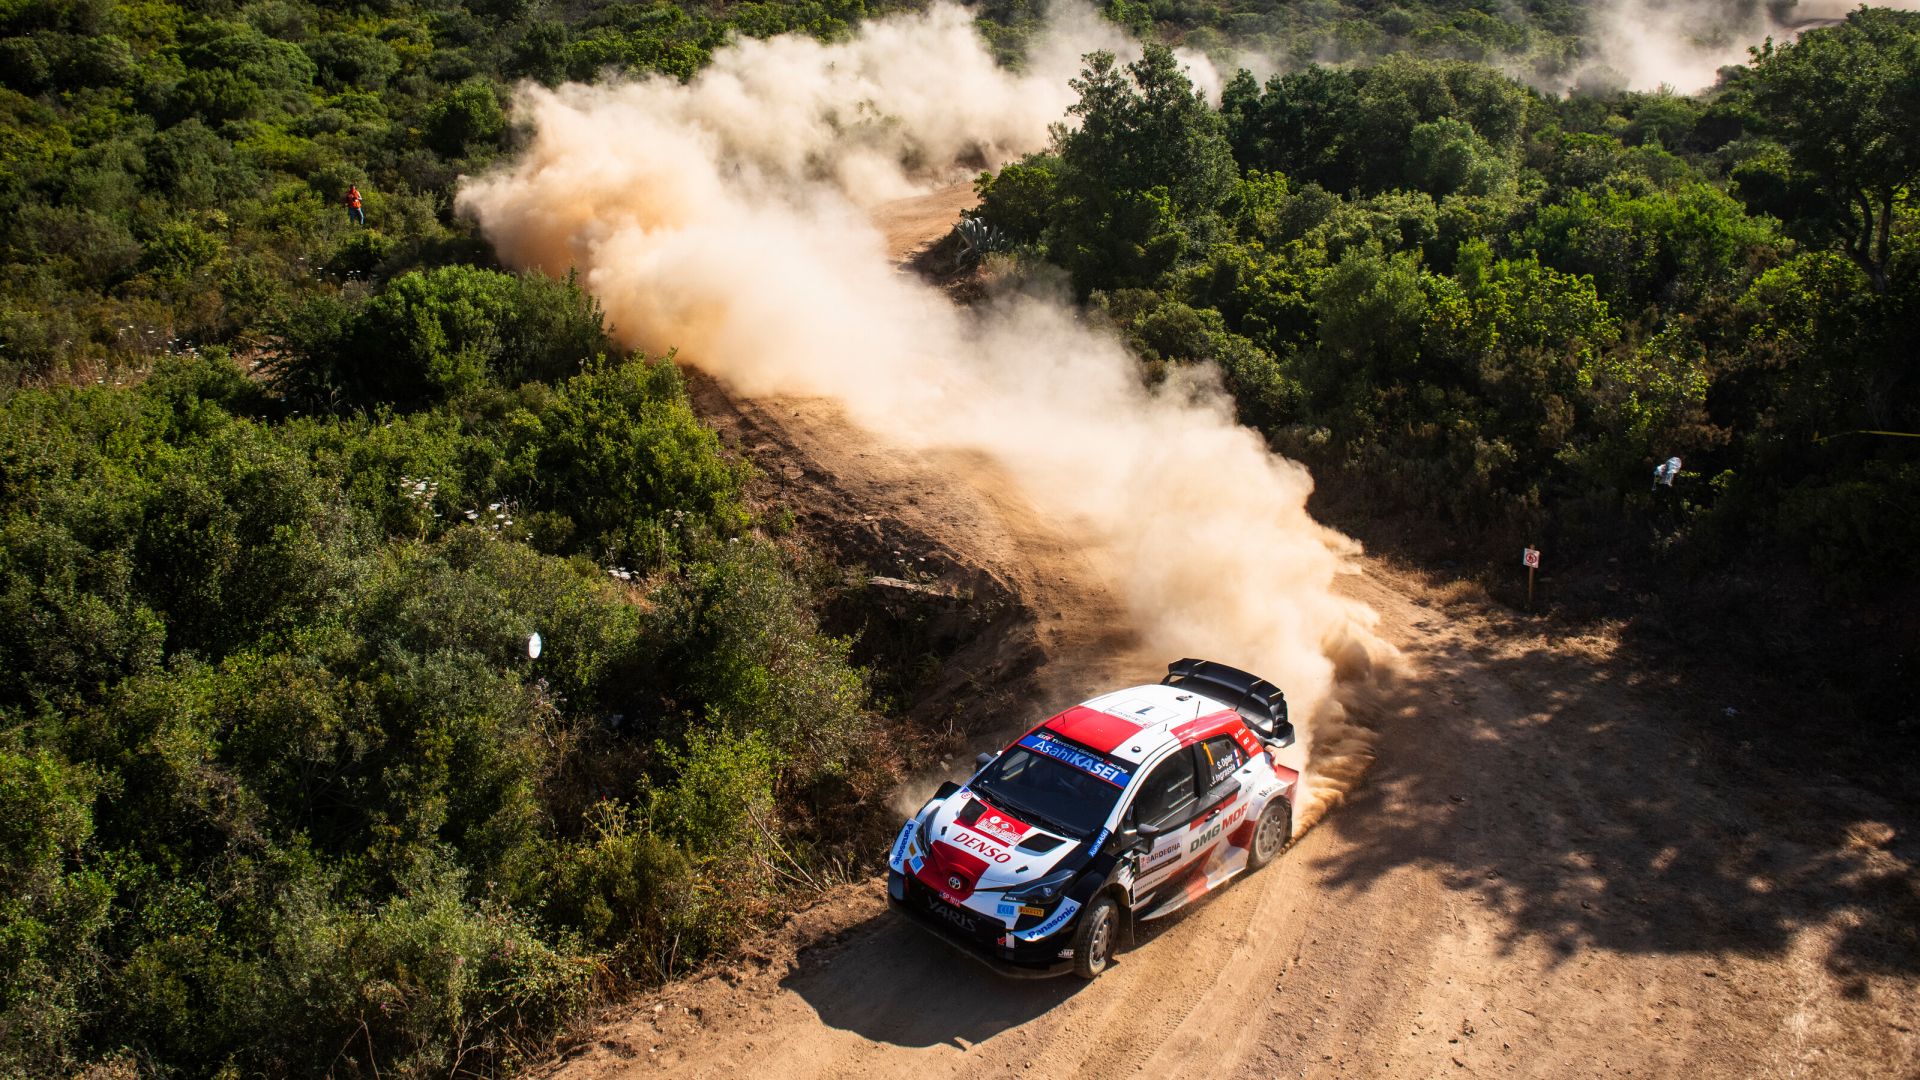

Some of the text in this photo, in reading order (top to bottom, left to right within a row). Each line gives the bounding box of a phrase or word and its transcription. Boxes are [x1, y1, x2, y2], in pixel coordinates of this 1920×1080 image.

[1052, 738, 1078, 752] TOYOTA
[1078, 747, 1104, 762] GAZOO
[1103, 758, 1128, 774] Racing
[893, 823, 915, 866] Panasonic
[953, 832, 1012, 864] DENSO
[1190, 823, 1221, 854] DMG
[928, 895, 977, 932] YARIS
[1027, 904, 1077, 939] Panasonic
